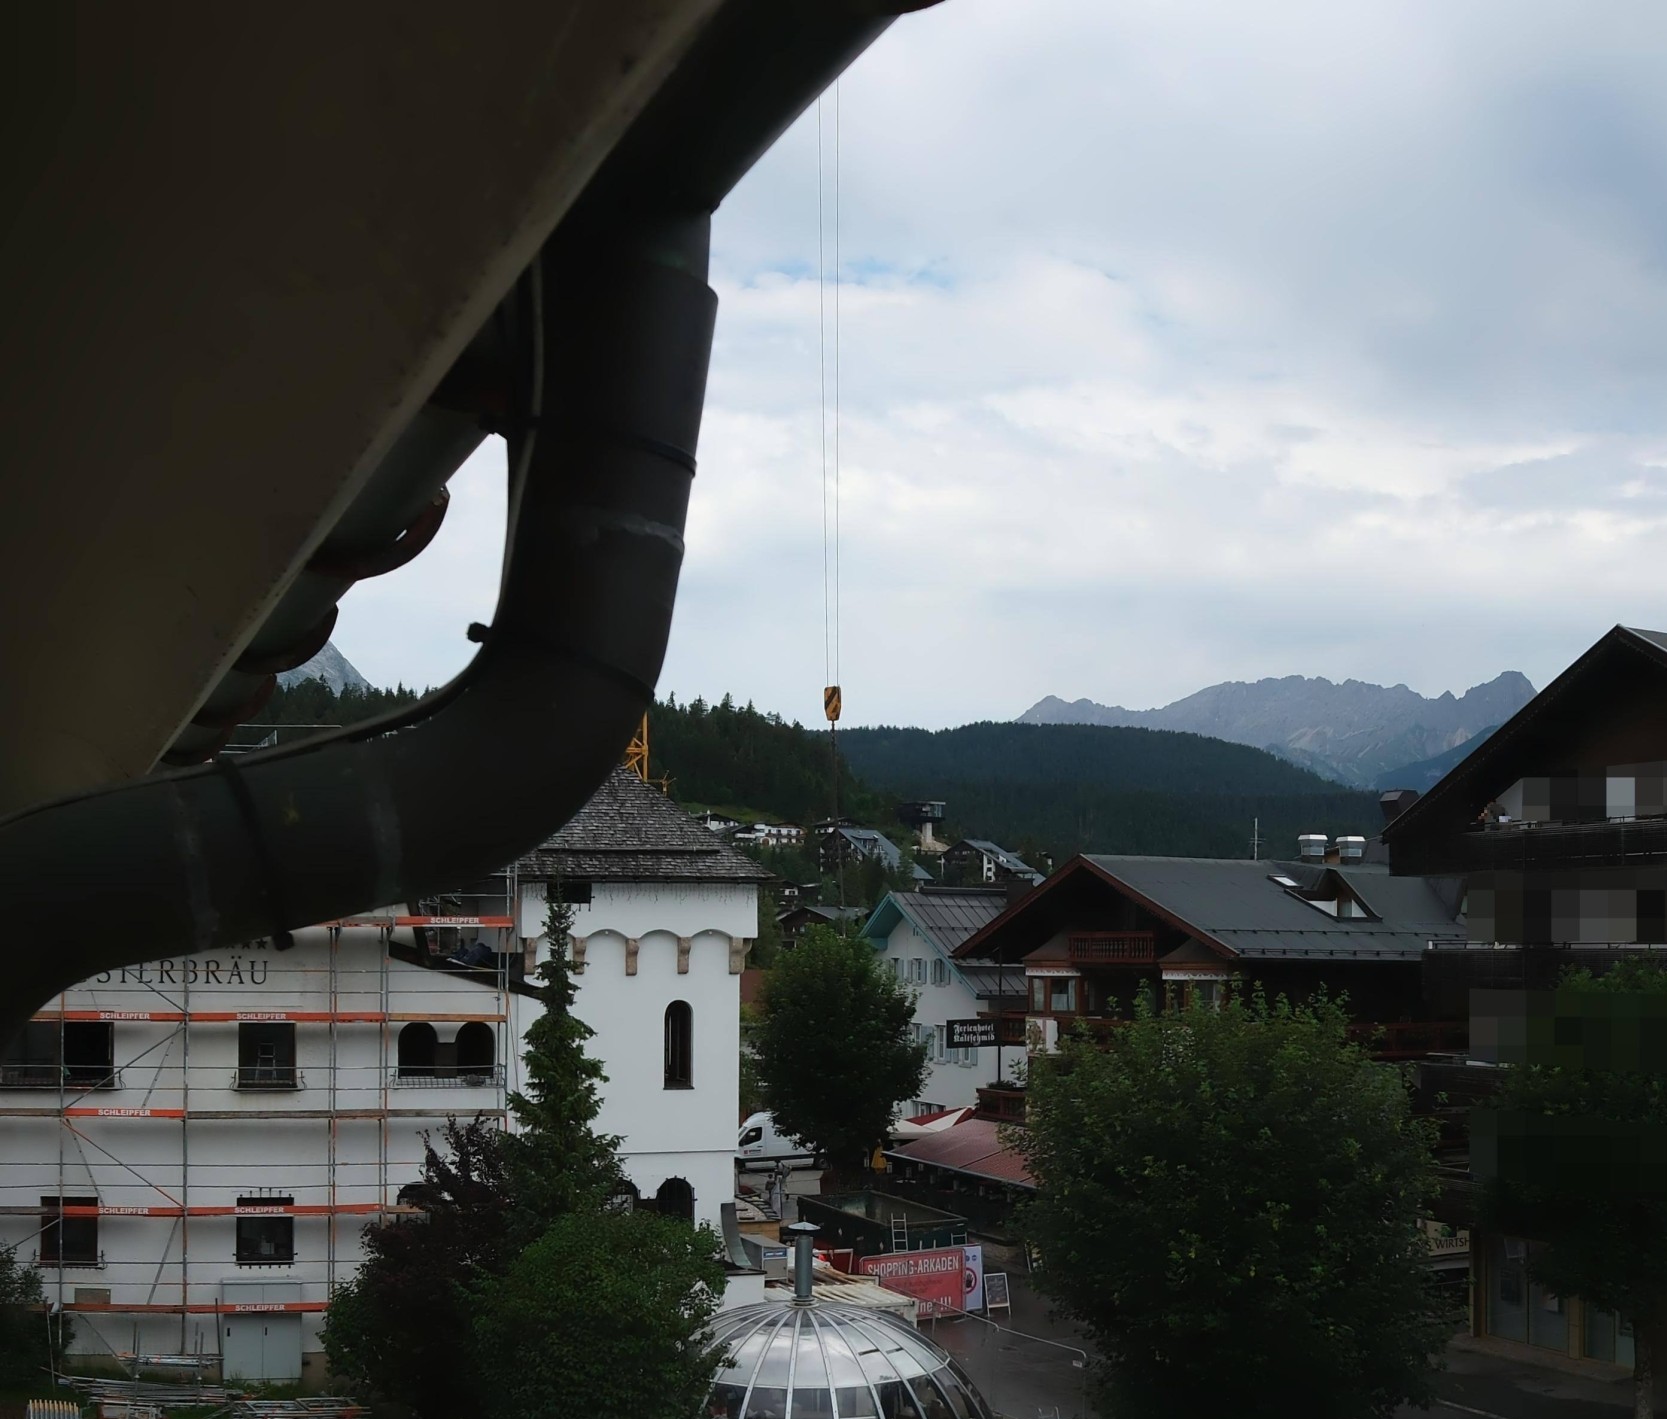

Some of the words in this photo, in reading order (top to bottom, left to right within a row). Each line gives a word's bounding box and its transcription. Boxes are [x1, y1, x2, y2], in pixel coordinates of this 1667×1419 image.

[83, 956, 268, 984] STERBRÄU
[100, 1012, 150, 1020] SCHLEIPFER
[98, 1109, 151, 1117] SCHLEIPFER
[99, 1207, 149, 1215] SCHLEIPFER
